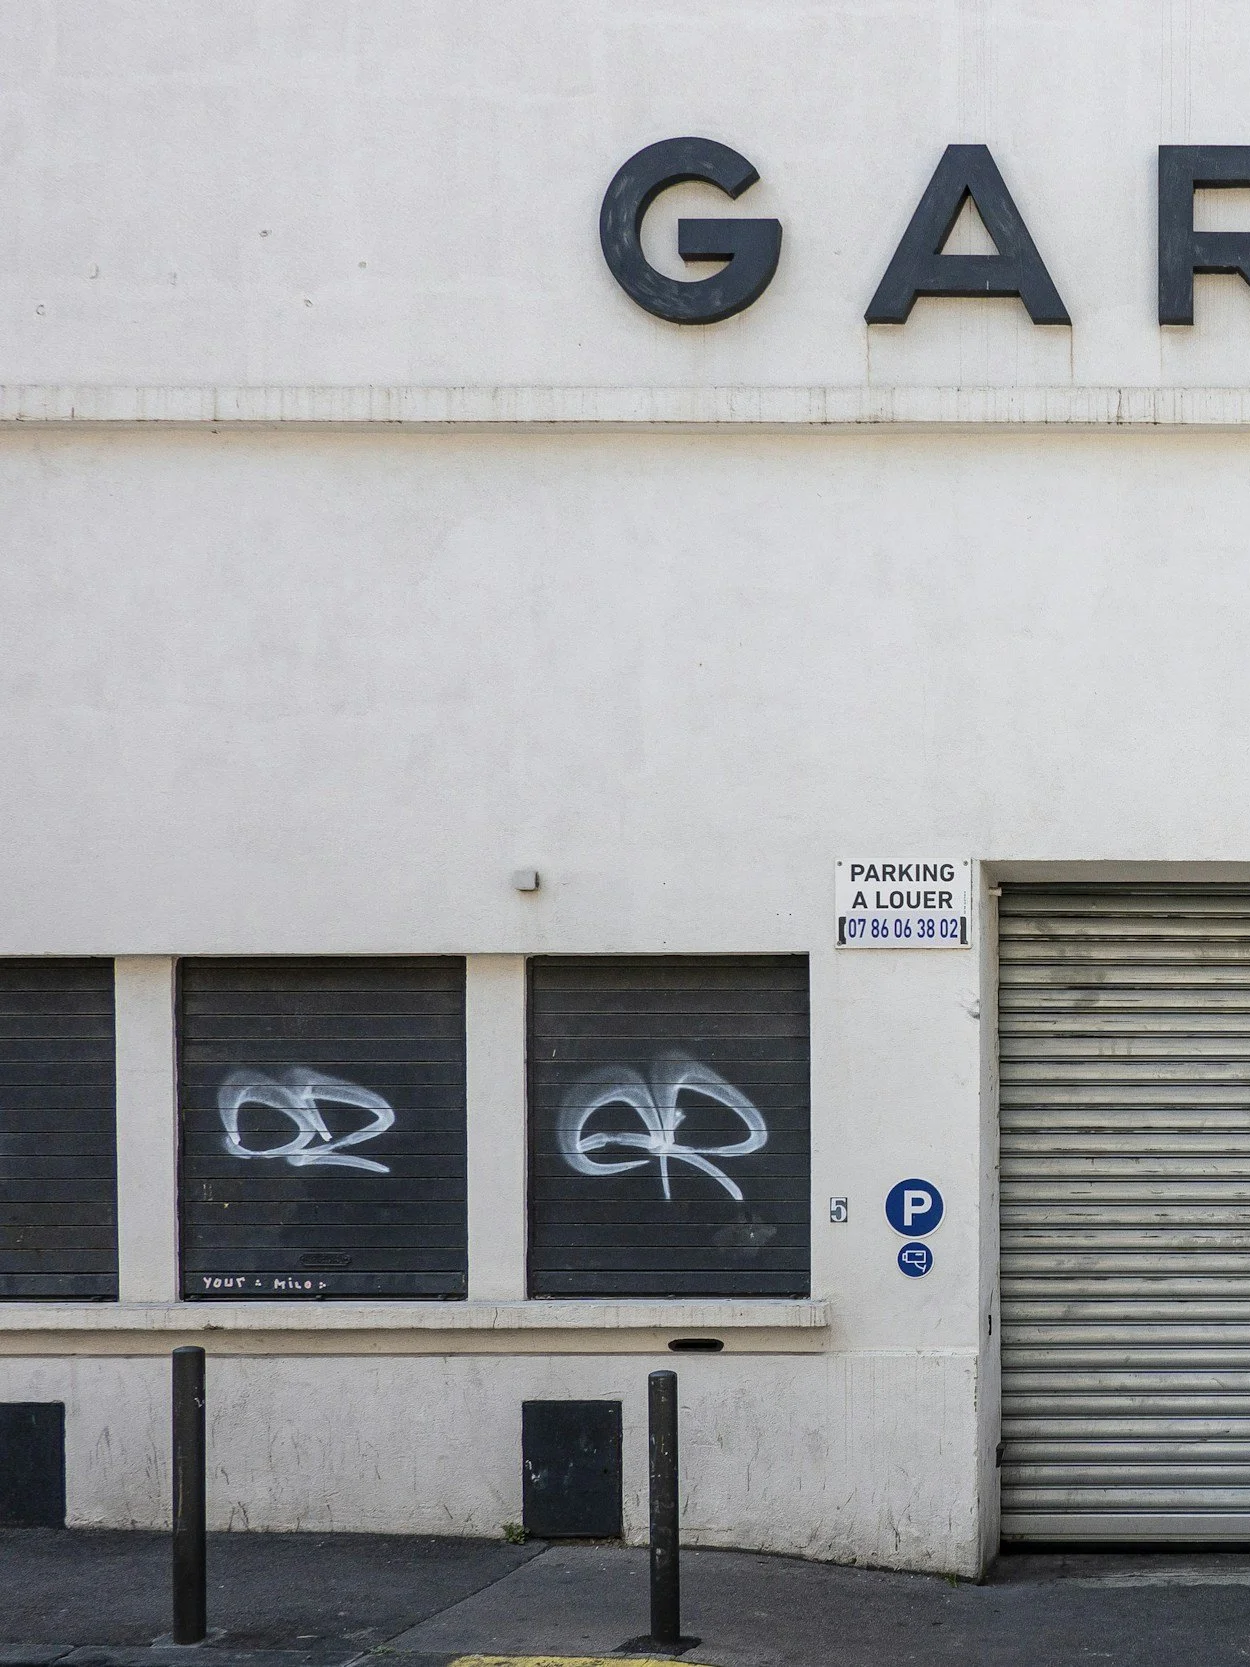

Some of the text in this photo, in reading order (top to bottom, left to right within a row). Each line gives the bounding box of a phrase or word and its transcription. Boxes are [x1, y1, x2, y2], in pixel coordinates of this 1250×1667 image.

[850, 863, 955, 882] PARKING
[851, 890, 868, 909] A
[875, 890, 953, 909] LOUER
[848, 918, 958, 939] 07 86 06 38 02
[830, 1197, 848, 1222] 5
[903, 1189, 933, 1226] P
